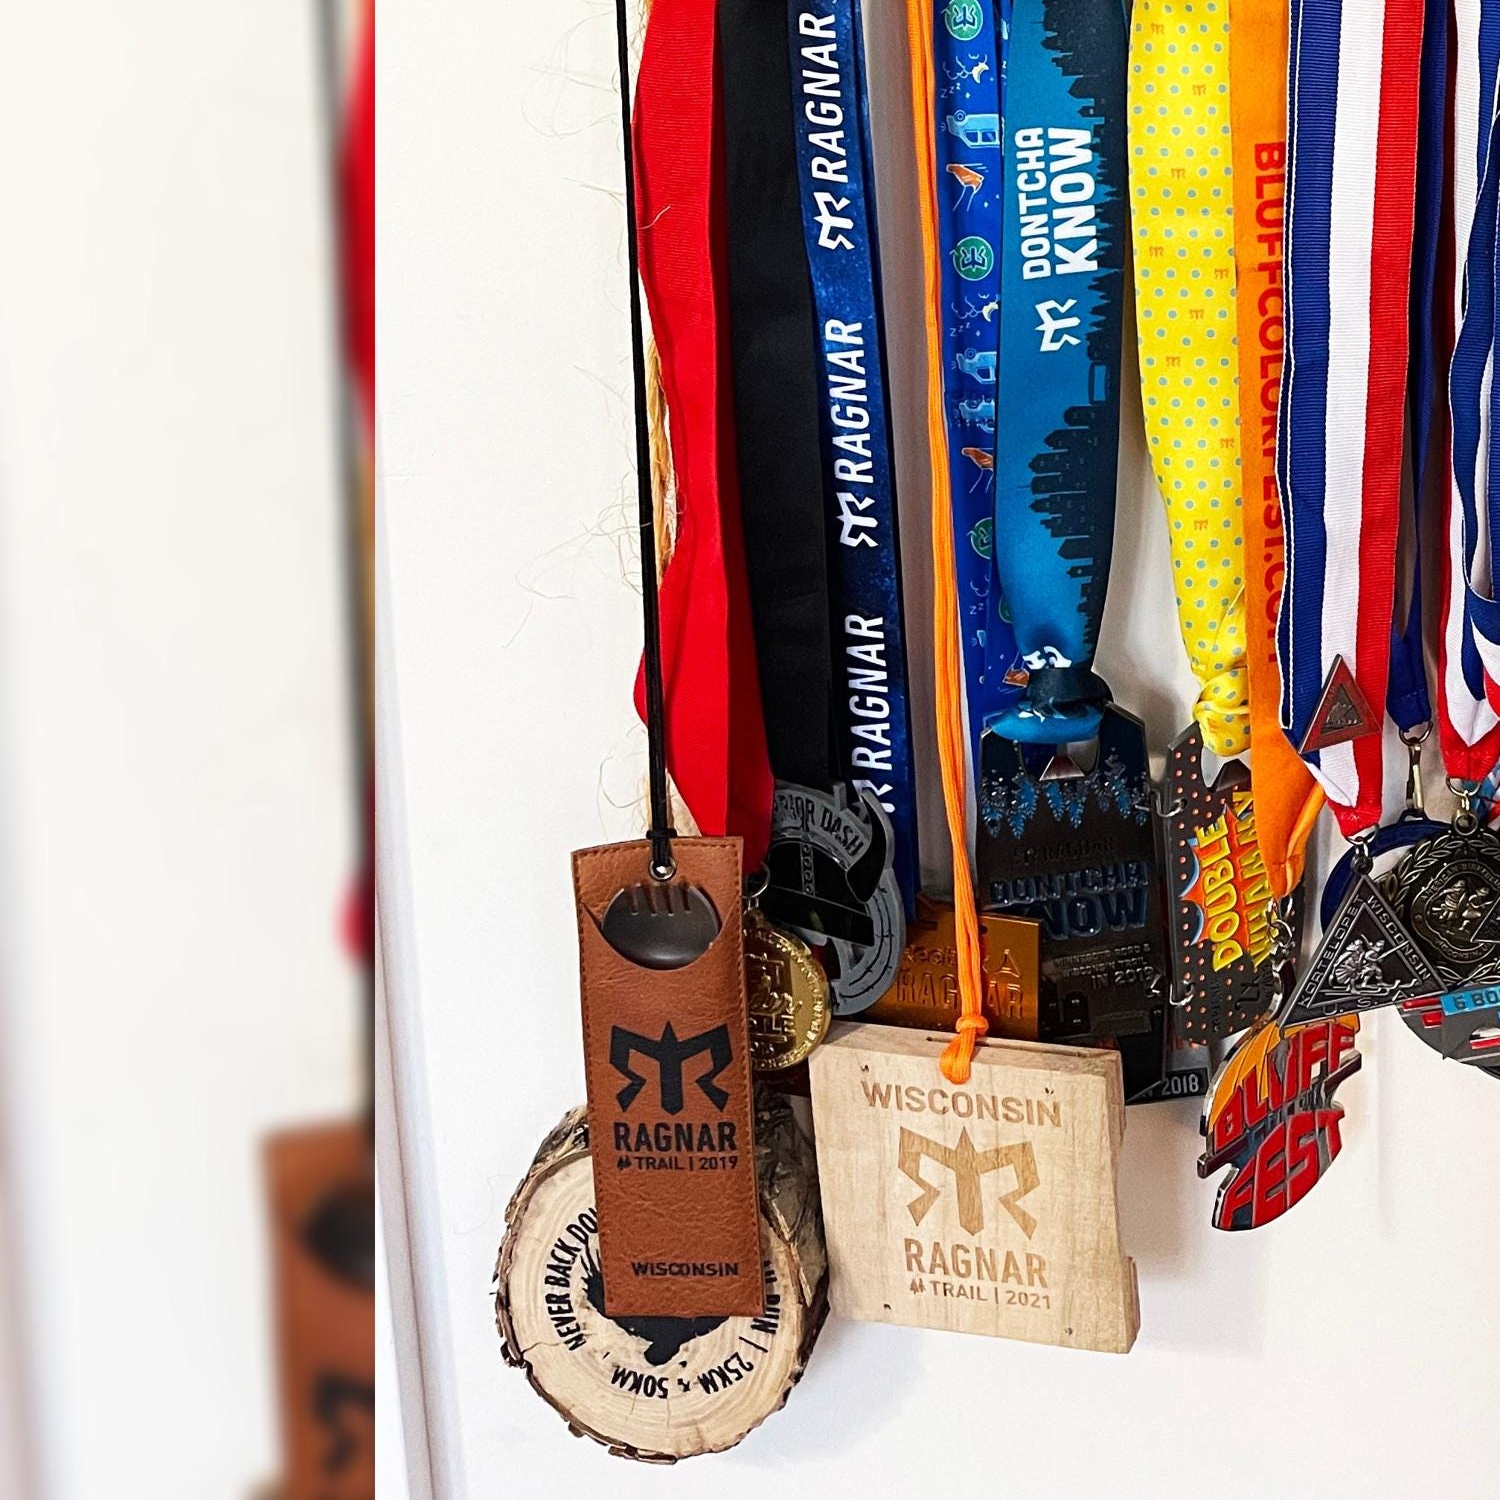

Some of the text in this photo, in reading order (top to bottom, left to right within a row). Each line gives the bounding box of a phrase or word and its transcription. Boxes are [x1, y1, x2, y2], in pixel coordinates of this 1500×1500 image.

[798, 11, 850, 184] RAGNAR
[1018, 125, 1052, 282] DONTCHA
[1048, 124, 1100, 276] KNOW
[824, 315, 875, 485] RAGNAR
[846, 612, 893, 772] RAGNAR
[820, 805, 865, 857] DASH
[1196, 812, 1244, 973] DOUBLE
[1299, 894, 1364, 1007] KORTELOPET
[1366, 894, 1433, 982] WISCONSIN
[896, 968, 1025, 1019] RAGAR
[860, 1078, 1063, 1129] WISCONSIN
[1161, 1073, 1200, 1098] 2018
[1213, 1021, 1356, 1153] BLUFF
[613, 1121, 738, 1153] RAGNAR
[635, 1154, 739, 1172] TRAIL 2019
[1219, 1109, 1346, 1230] FEST
[545, 1236, 582, 1289] BACK
[630, 1260, 740, 1278] WISCONSIN
[903, 1236, 1050, 1290] RAGNAR
[544, 1292, 587, 1351] NEVER
[929, 1280, 1052, 1311] TRAIL 2021
[609, 1364, 670, 1400] 50KM
[697, 1350, 755, 1397] 25KM
